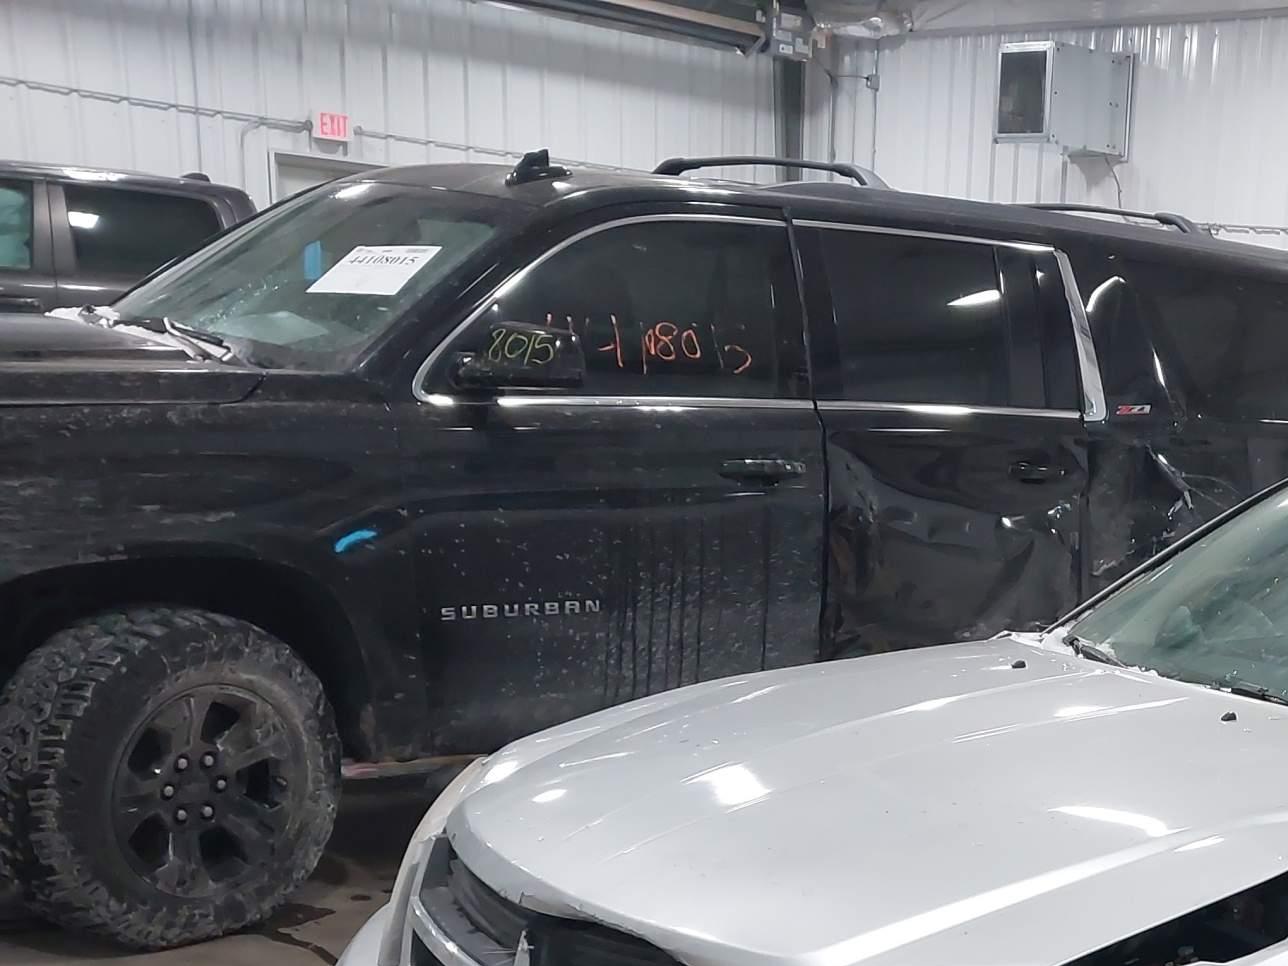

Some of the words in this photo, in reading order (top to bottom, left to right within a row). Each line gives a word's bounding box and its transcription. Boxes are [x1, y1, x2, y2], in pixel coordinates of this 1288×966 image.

[320, 112, 348, 137] EXIT
[349, 255, 419, 265] 44108015
[488, 328, 555, 366] 8015
[441, 600, 600, 620] SUBURBAN
